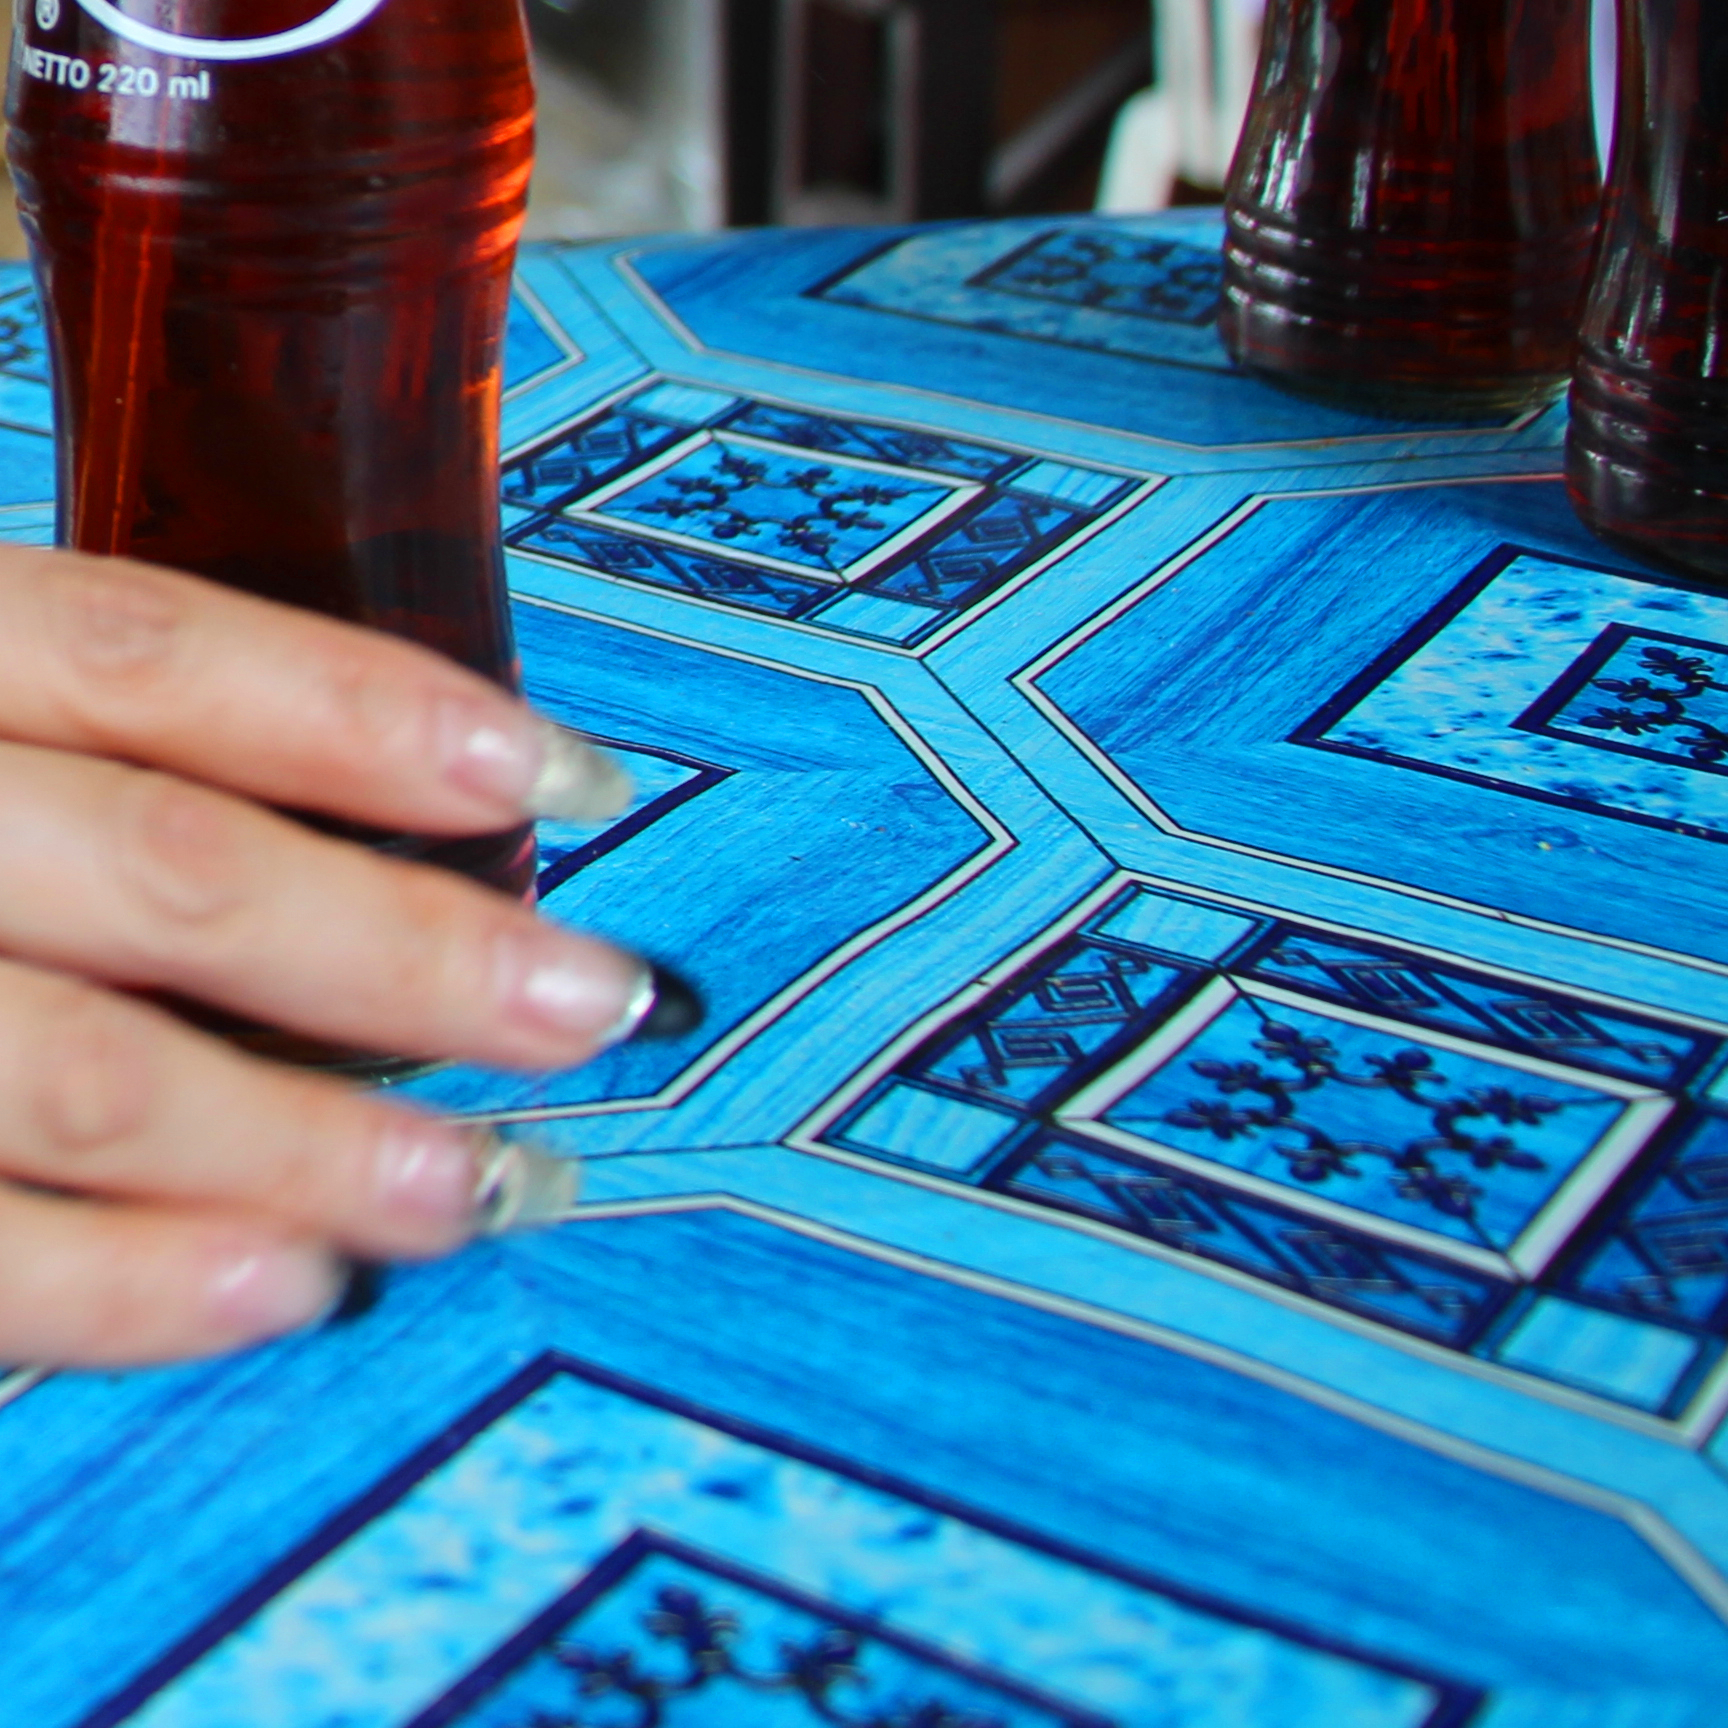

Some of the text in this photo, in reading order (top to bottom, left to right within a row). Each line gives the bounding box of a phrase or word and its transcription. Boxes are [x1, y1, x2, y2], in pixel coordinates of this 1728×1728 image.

[22, 45, 211, 100] NETTO 220 ml
